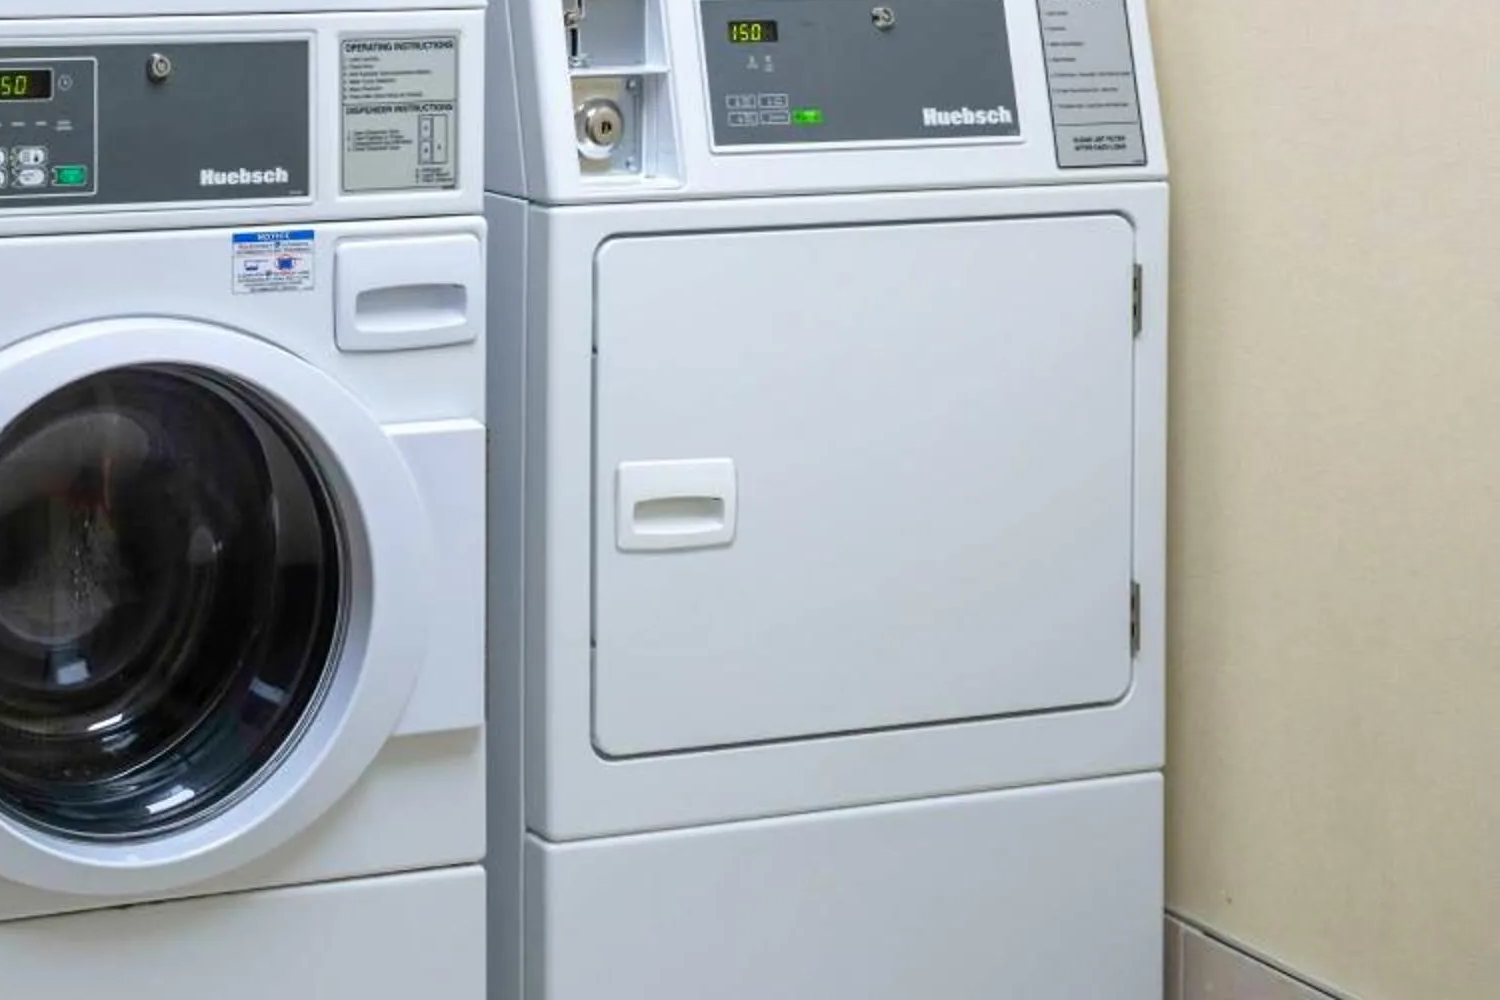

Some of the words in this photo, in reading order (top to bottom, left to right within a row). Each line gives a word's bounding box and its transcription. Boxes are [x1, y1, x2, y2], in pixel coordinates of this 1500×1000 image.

[732, 23, 761, 41] 150
[345, 42, 393, 53] OPERATING
[922, 105, 1013, 126] Huebsch
[200, 166, 288, 186] Huebsch
